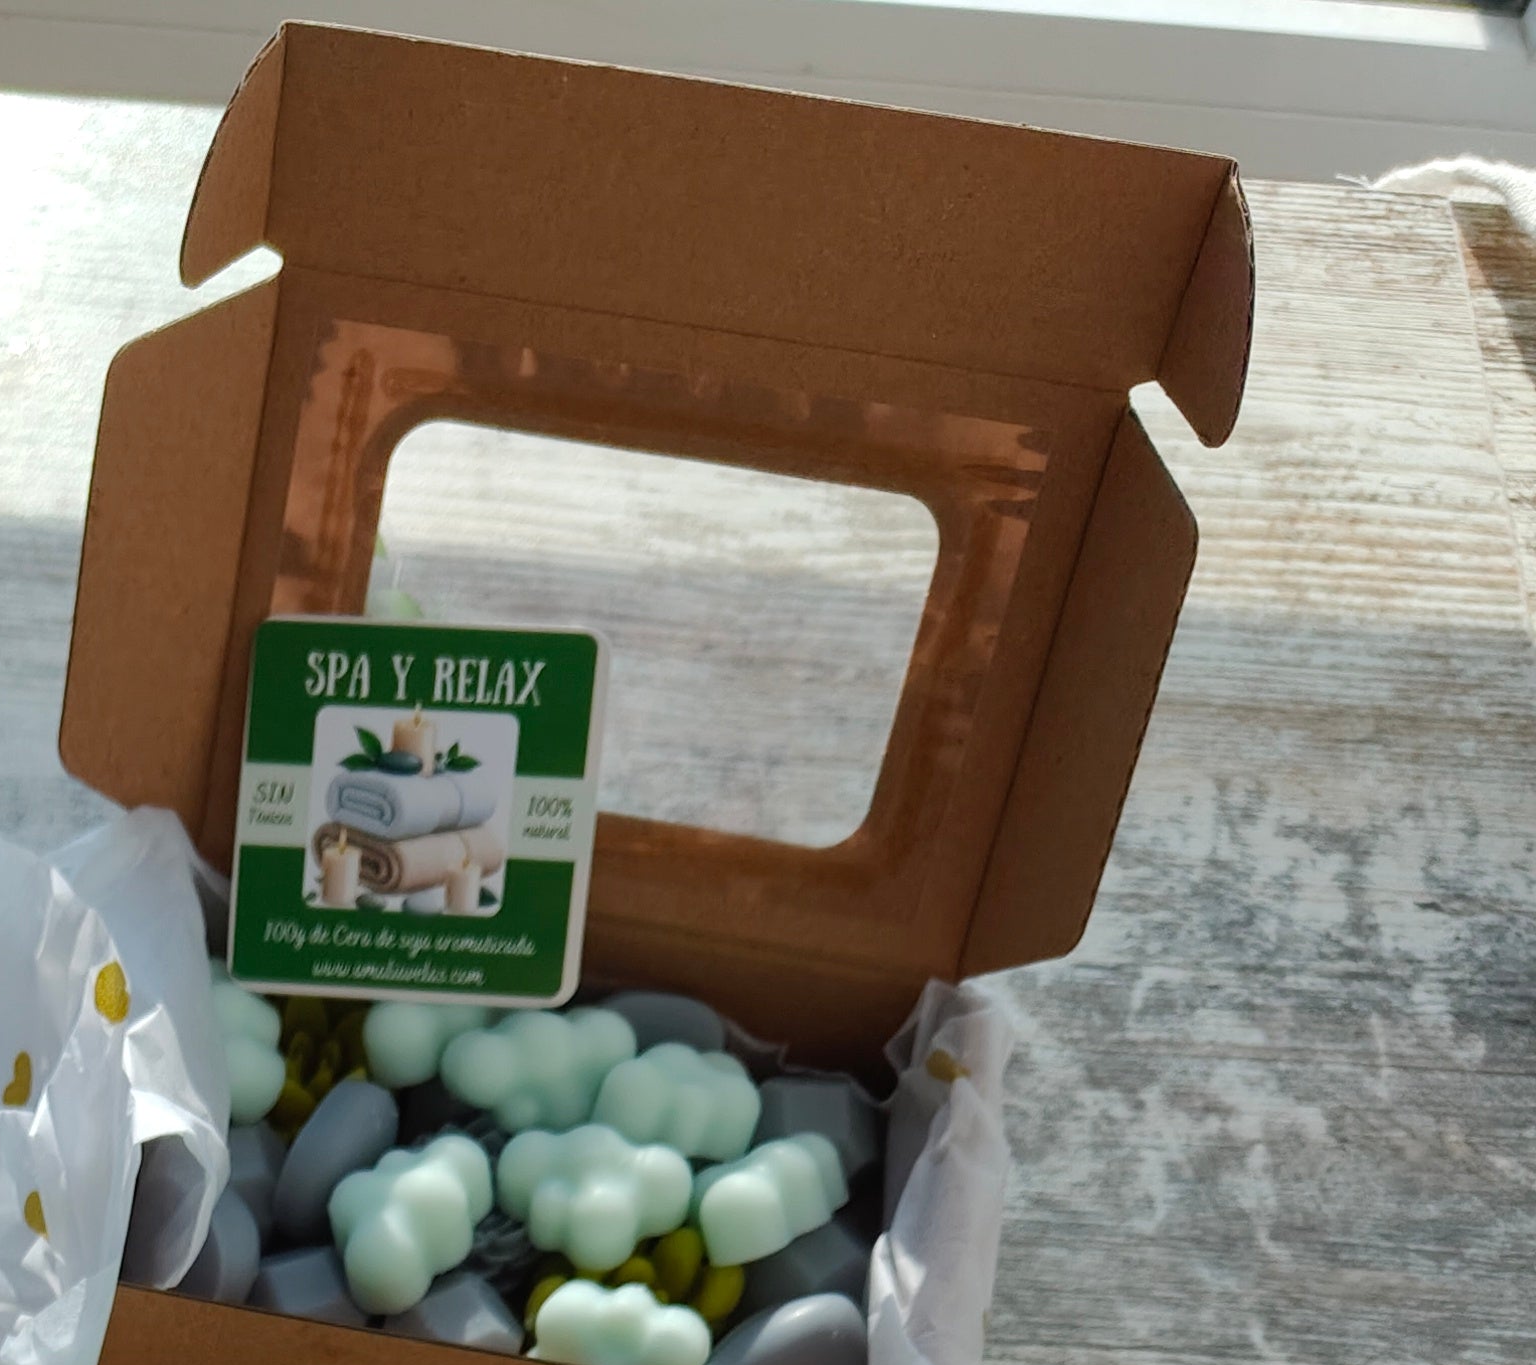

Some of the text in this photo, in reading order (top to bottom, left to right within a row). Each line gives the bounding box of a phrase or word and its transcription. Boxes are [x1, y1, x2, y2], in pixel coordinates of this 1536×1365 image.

[305, 650, 546, 706] SPA Y RELAX
[254, 782, 295, 805] SIN
[527, 795, 575, 819] 100%
